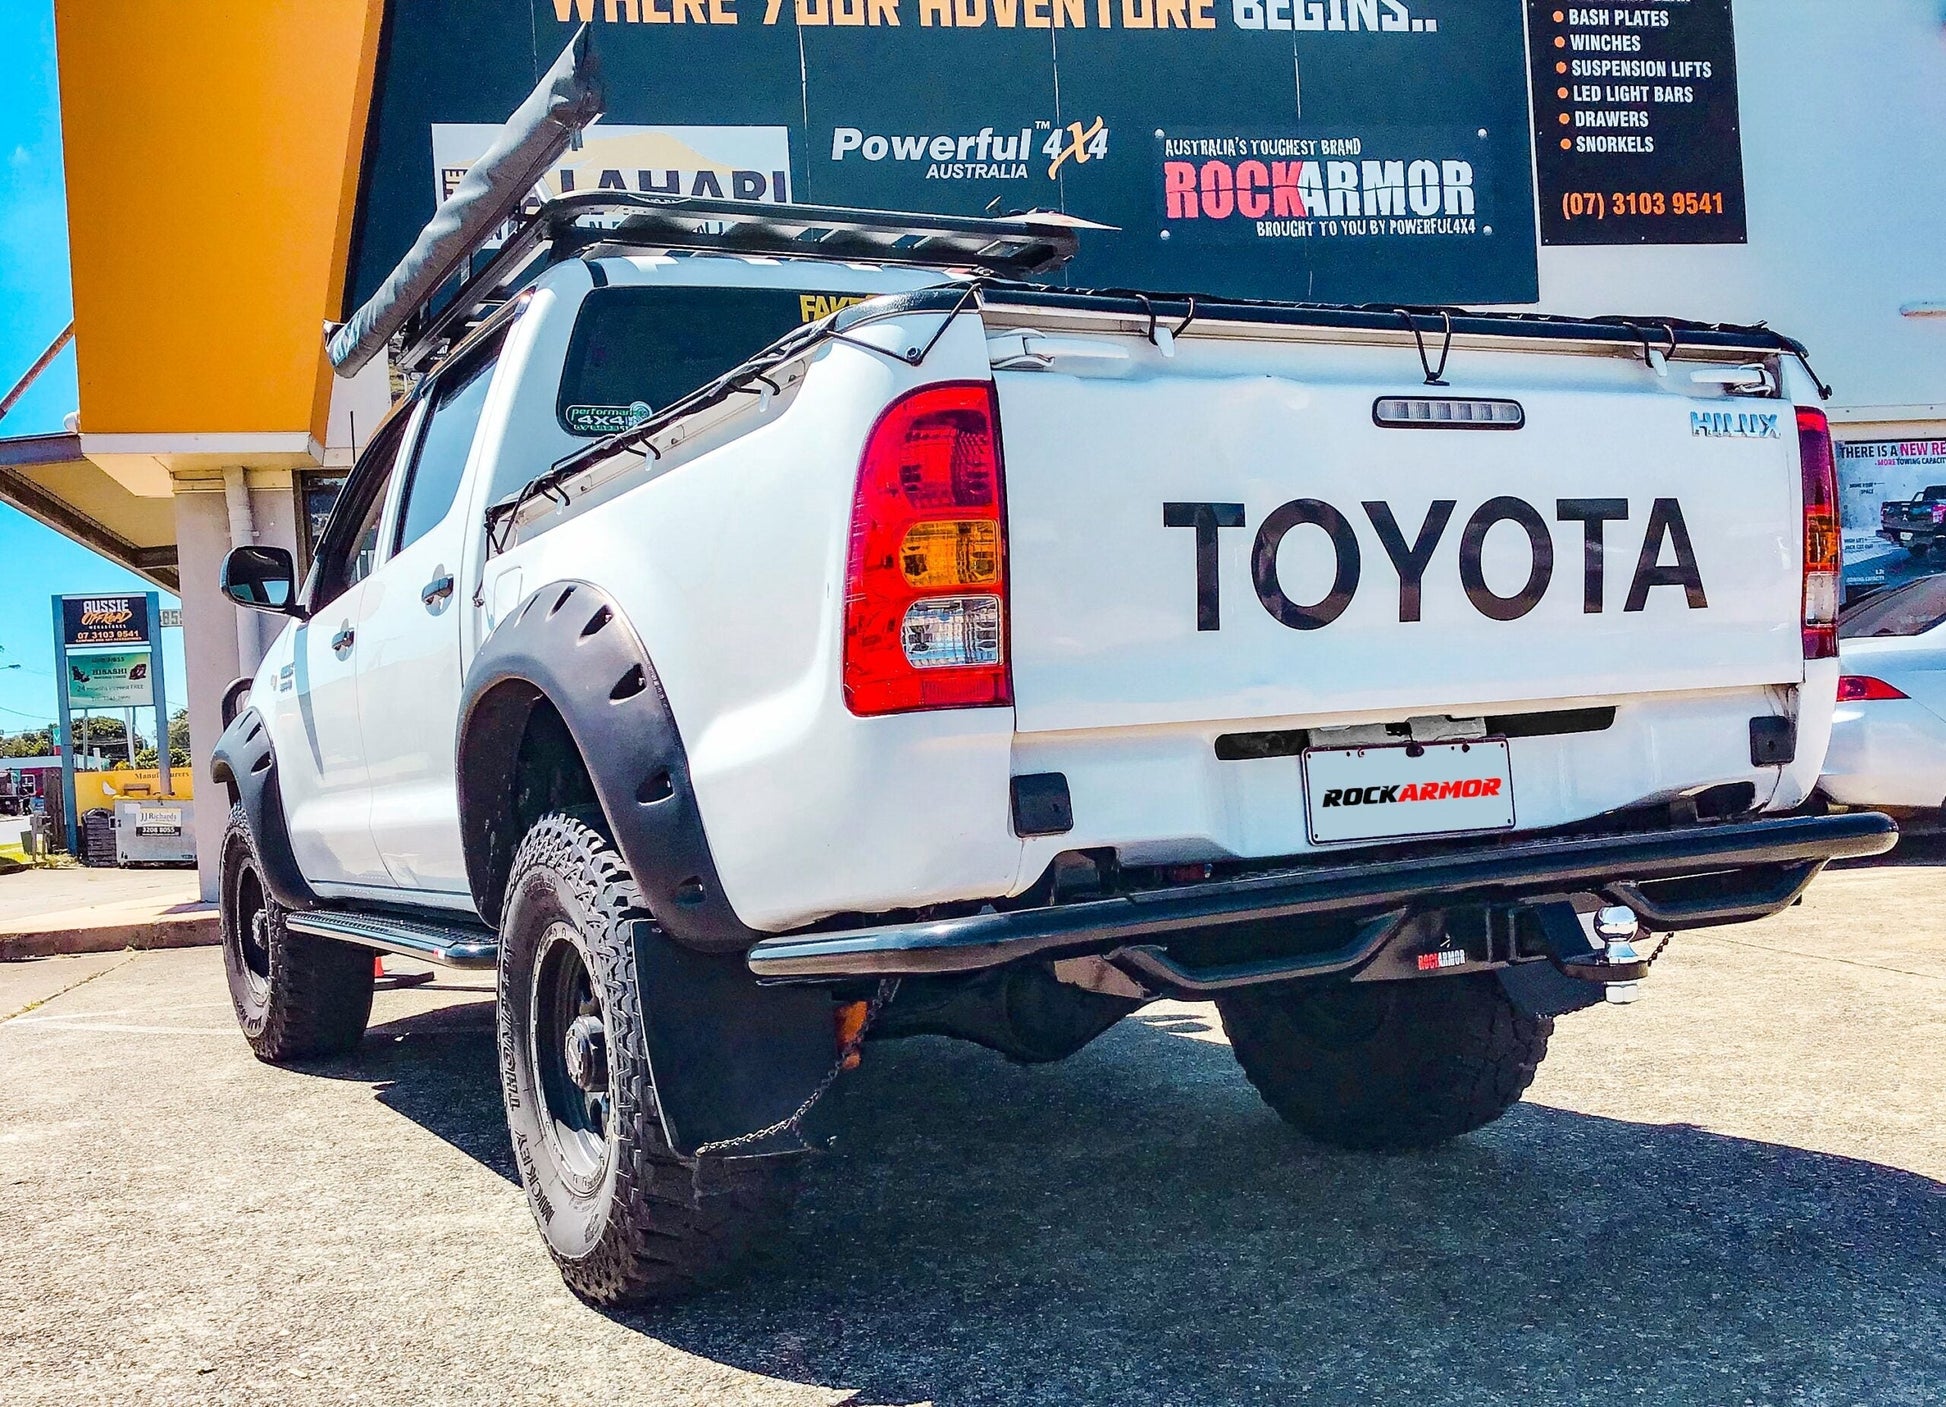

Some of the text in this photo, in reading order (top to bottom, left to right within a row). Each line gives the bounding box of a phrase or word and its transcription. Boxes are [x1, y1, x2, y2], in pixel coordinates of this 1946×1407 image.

[1568, 9, 1669, 27] BASH PLATES
[1570, 34, 1641, 51] WINCHES
[1571, 60, 1712, 78] SUSPENSION LIFTS
[1573, 85, 1694, 103] LED LIGHT BARS
[1575, 111, 1649, 127] DRAWERS
[831, 127, 1032, 161] Powerful
[1165, 137, 1361, 157] AUSTRALIA'S TOUGHEST BRAND
[1576, 136, 1654, 152] SNORKELS
[926, 163, 1028, 179] AUSTRALIA
[1562, 192, 1723, 219] (07) 3103 9541
[1256, 218, 1476, 237] BROUGHT TO YOU BY POWERFUL4X4
[1690, 411, 1781, 438] HILUX
[1840, 446, 1874, 458] THERE
[1878, 445, 1888, 457] IS
[1890, 445, 1898, 456] A
[1900, 443, 1928, 456] NEW
[1163, 495, 1708, 631] TOYOTA
[83, 600, 129, 613] AUSSIE
[92, 631, 115, 639] 3103
[1323, 777, 1502, 807] ROCKARMOR
[514, 1130, 556, 1226] MICKEY
